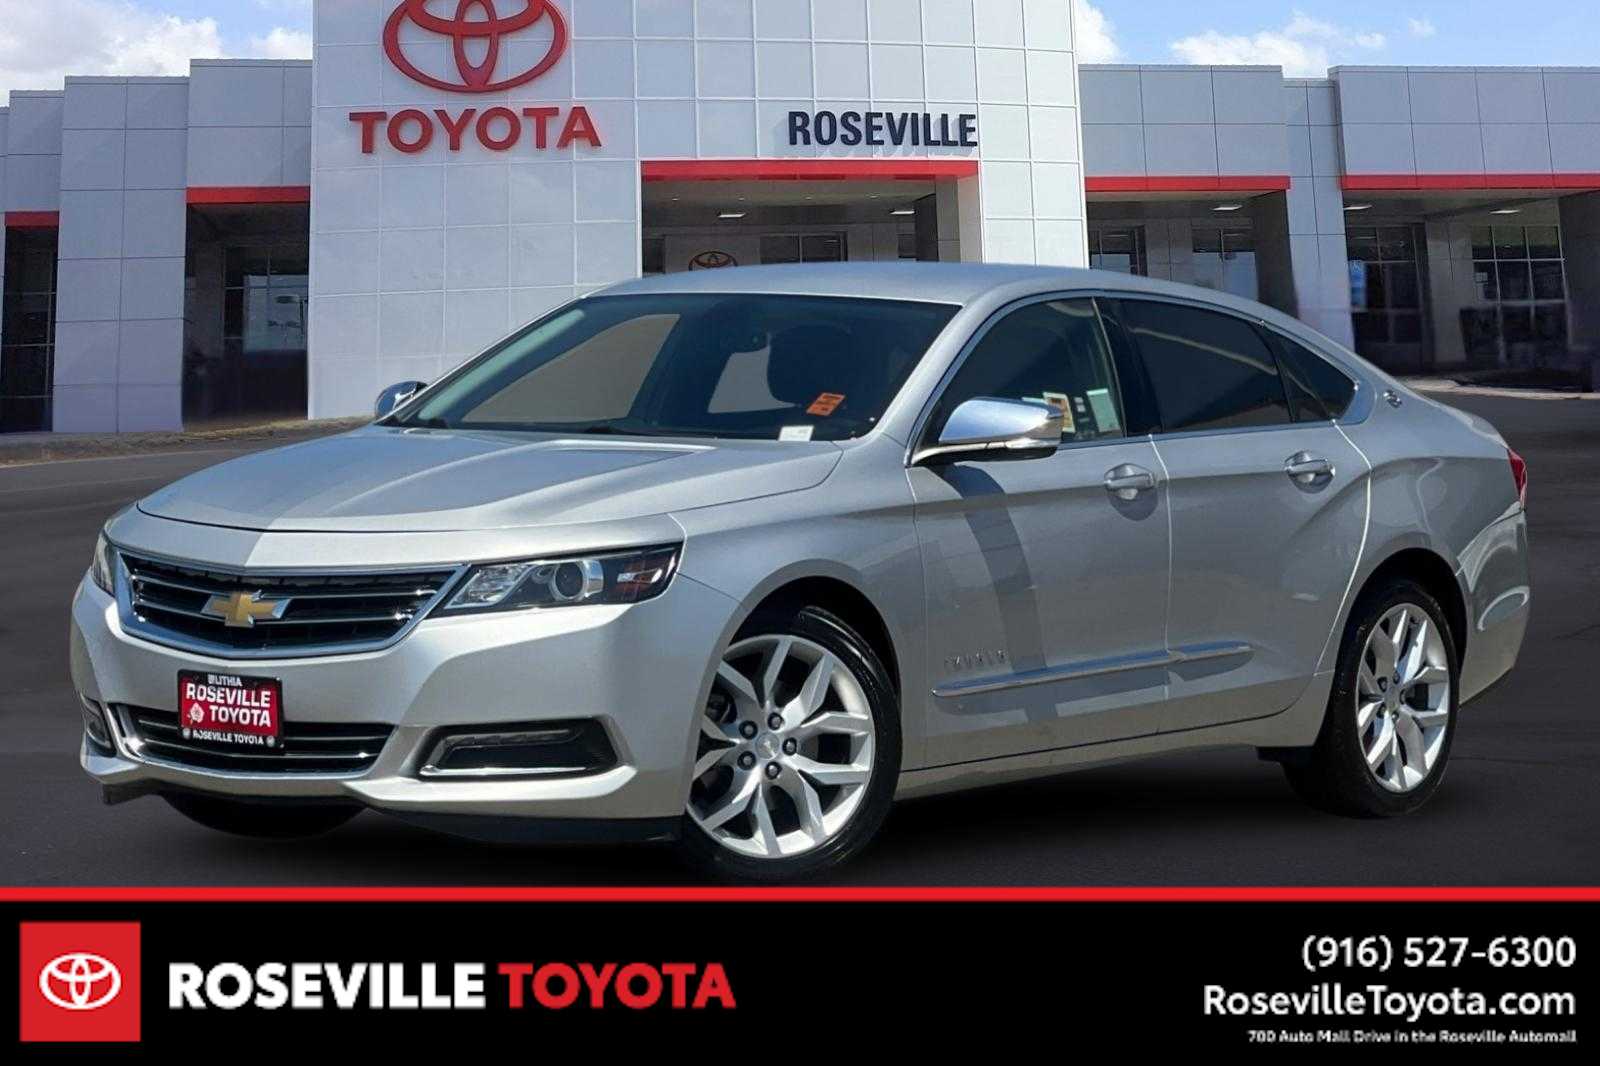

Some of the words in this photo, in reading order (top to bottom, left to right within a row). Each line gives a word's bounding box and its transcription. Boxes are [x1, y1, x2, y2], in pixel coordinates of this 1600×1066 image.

[349, 106, 602, 154] TOYOTA
[788, 111, 978, 147] ROSEVILLE
[215, 675, 243, 687] LITHIA
[186, 683, 271, 708] ROSEVILLE
[209, 705, 271, 727] TOYOTA
[192, 730, 232, 742] ROSEVILLE
[233, 733, 264, 745] TOYOTA
